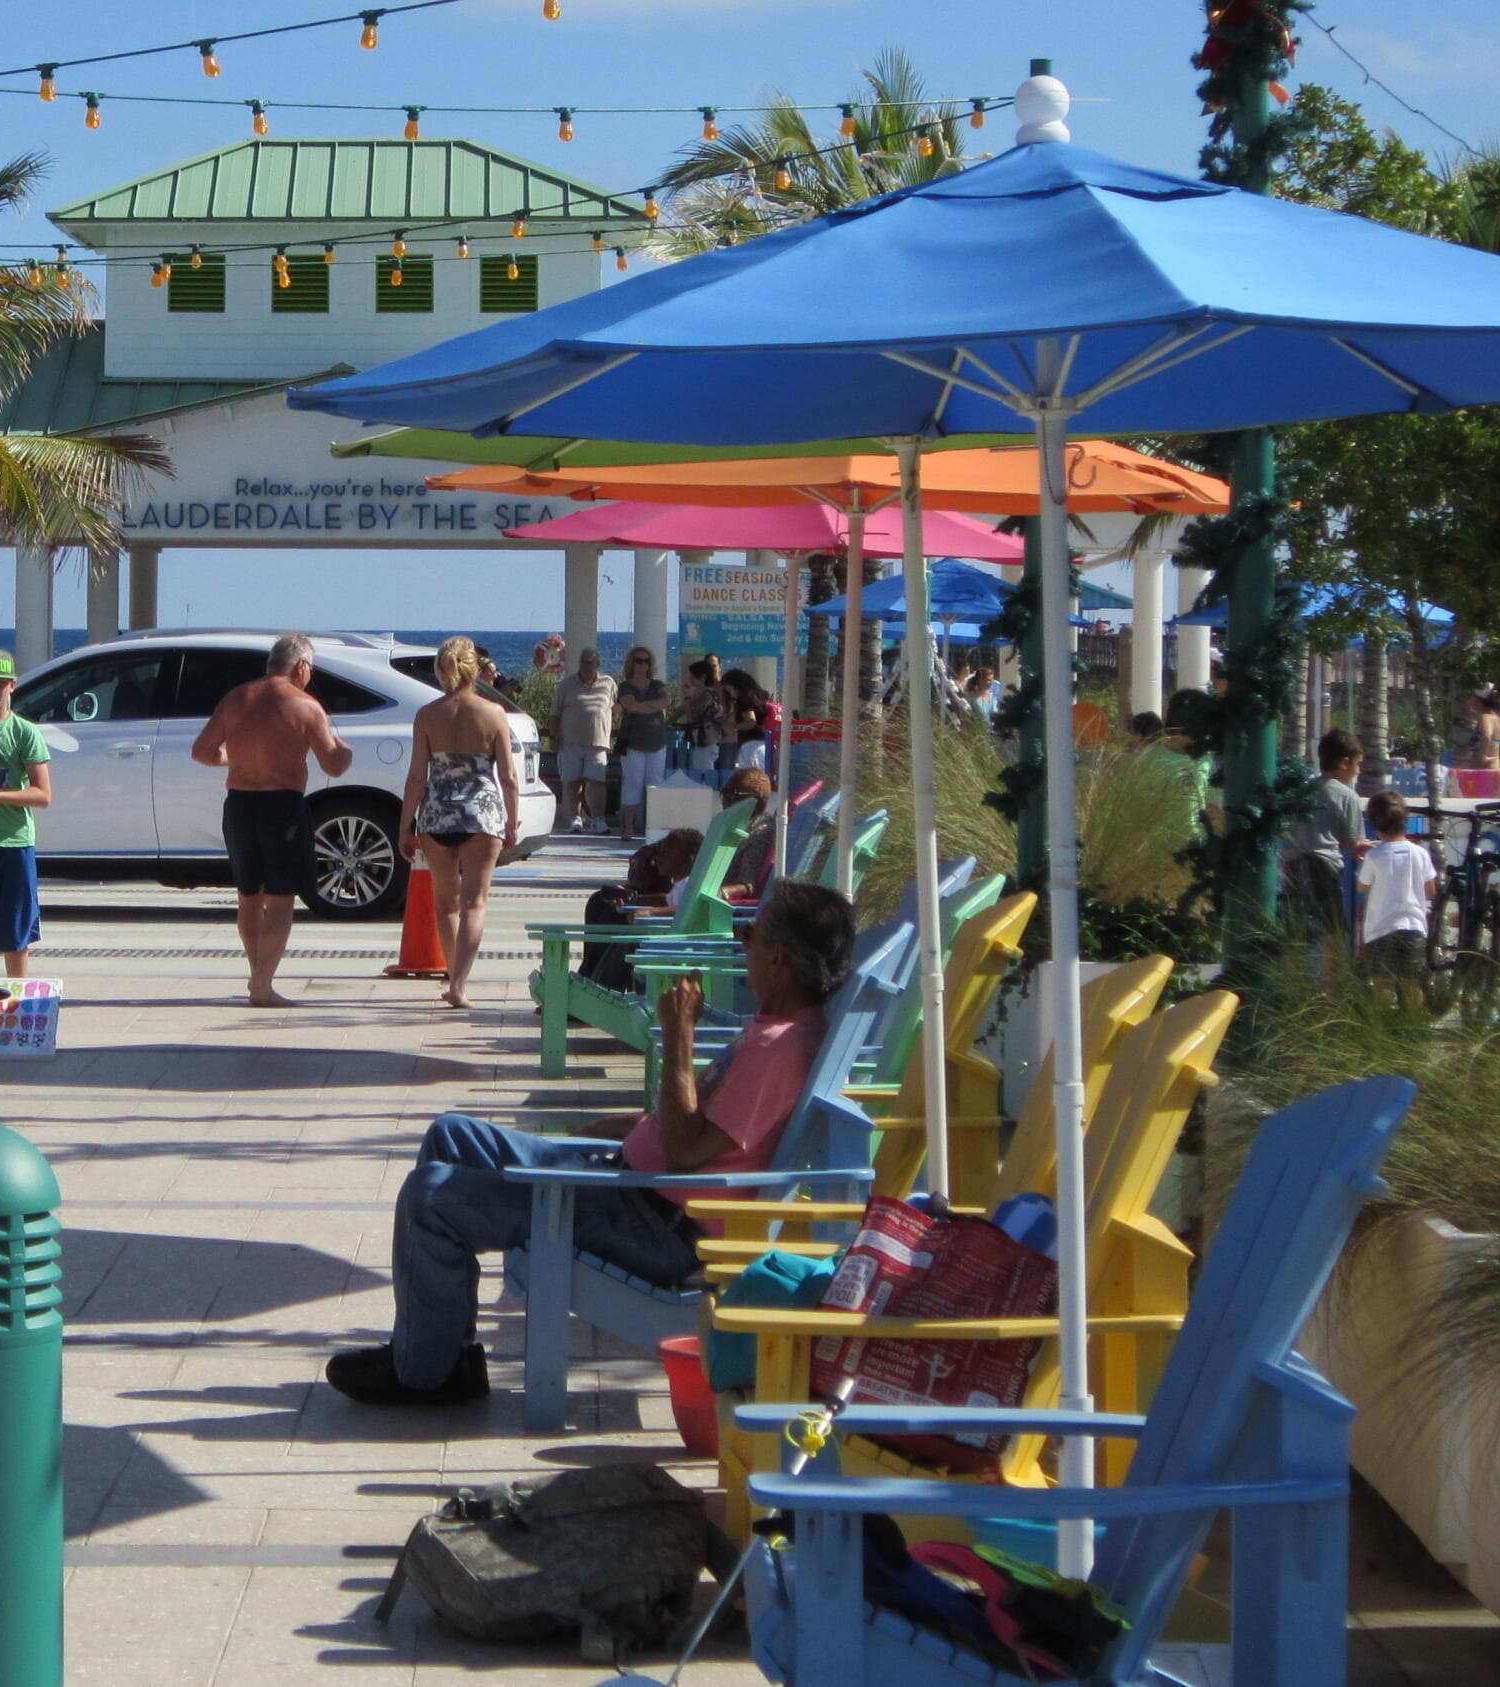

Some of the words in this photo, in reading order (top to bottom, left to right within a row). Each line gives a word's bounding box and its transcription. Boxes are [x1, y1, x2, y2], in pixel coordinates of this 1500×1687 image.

[380, 478, 427, 497] here
[121, 503, 342, 529] LAUDERDALE
[358, 503, 399, 529] BY
[412, 503, 477, 530] THE
[493, 503, 555, 530] SEA
[684, 567, 723, 584] FREE
[725, 570, 782, 584] SEASIDE
[693, 587, 736, 601] DANCE
[742, 587, 803, 601] CLASSS
[722, 621, 764, 632] Beginning
[727, 633, 744, 642] 2nd
